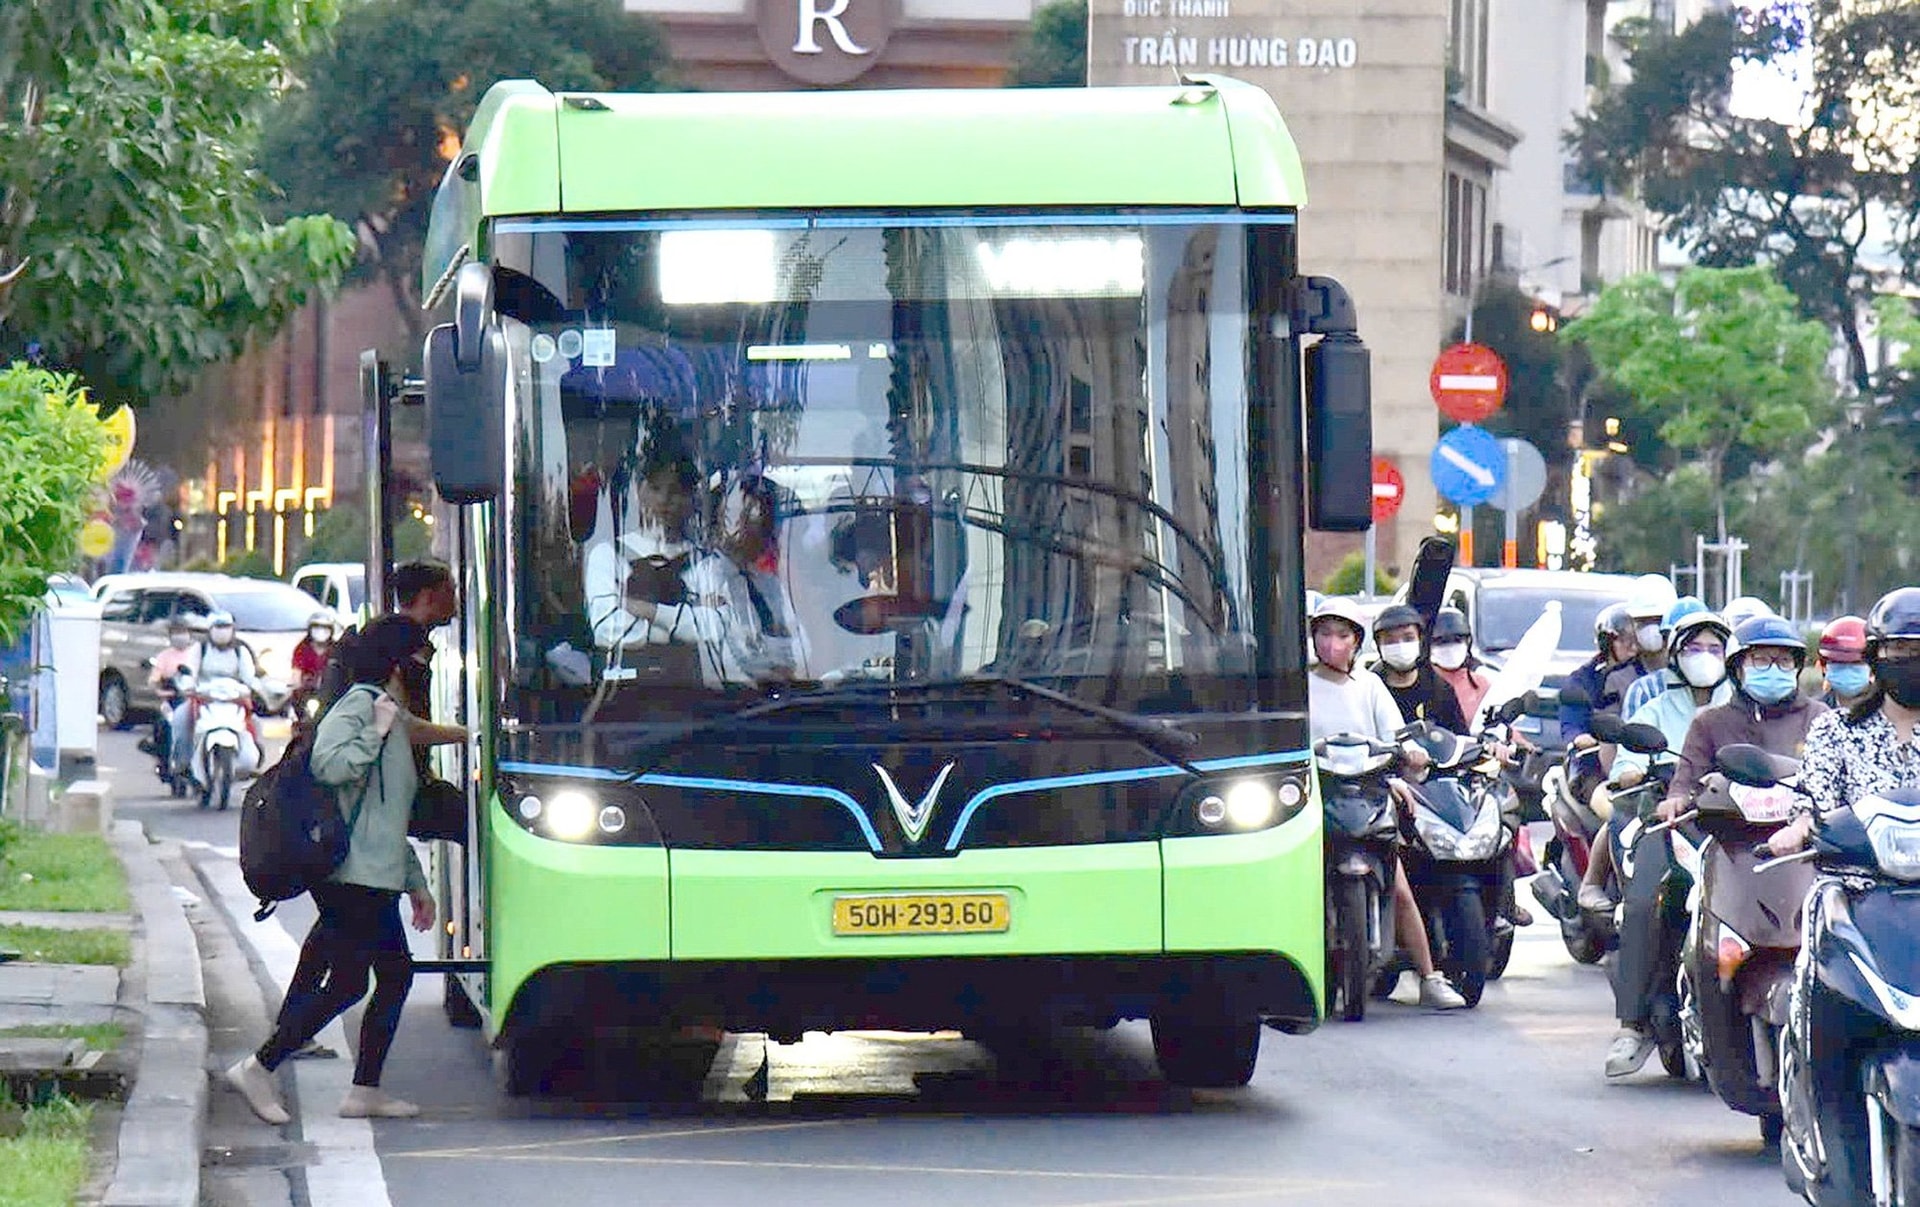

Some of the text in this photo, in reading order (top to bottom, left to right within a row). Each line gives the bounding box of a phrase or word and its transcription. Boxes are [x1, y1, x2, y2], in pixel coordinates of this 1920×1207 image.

[792, 0, 869, 54] R
[1208, 33, 1288, 67] HƯNG
[1297, 37, 1357, 73] ĐẠO
[849, 902, 993, 927] 50H-293.60
